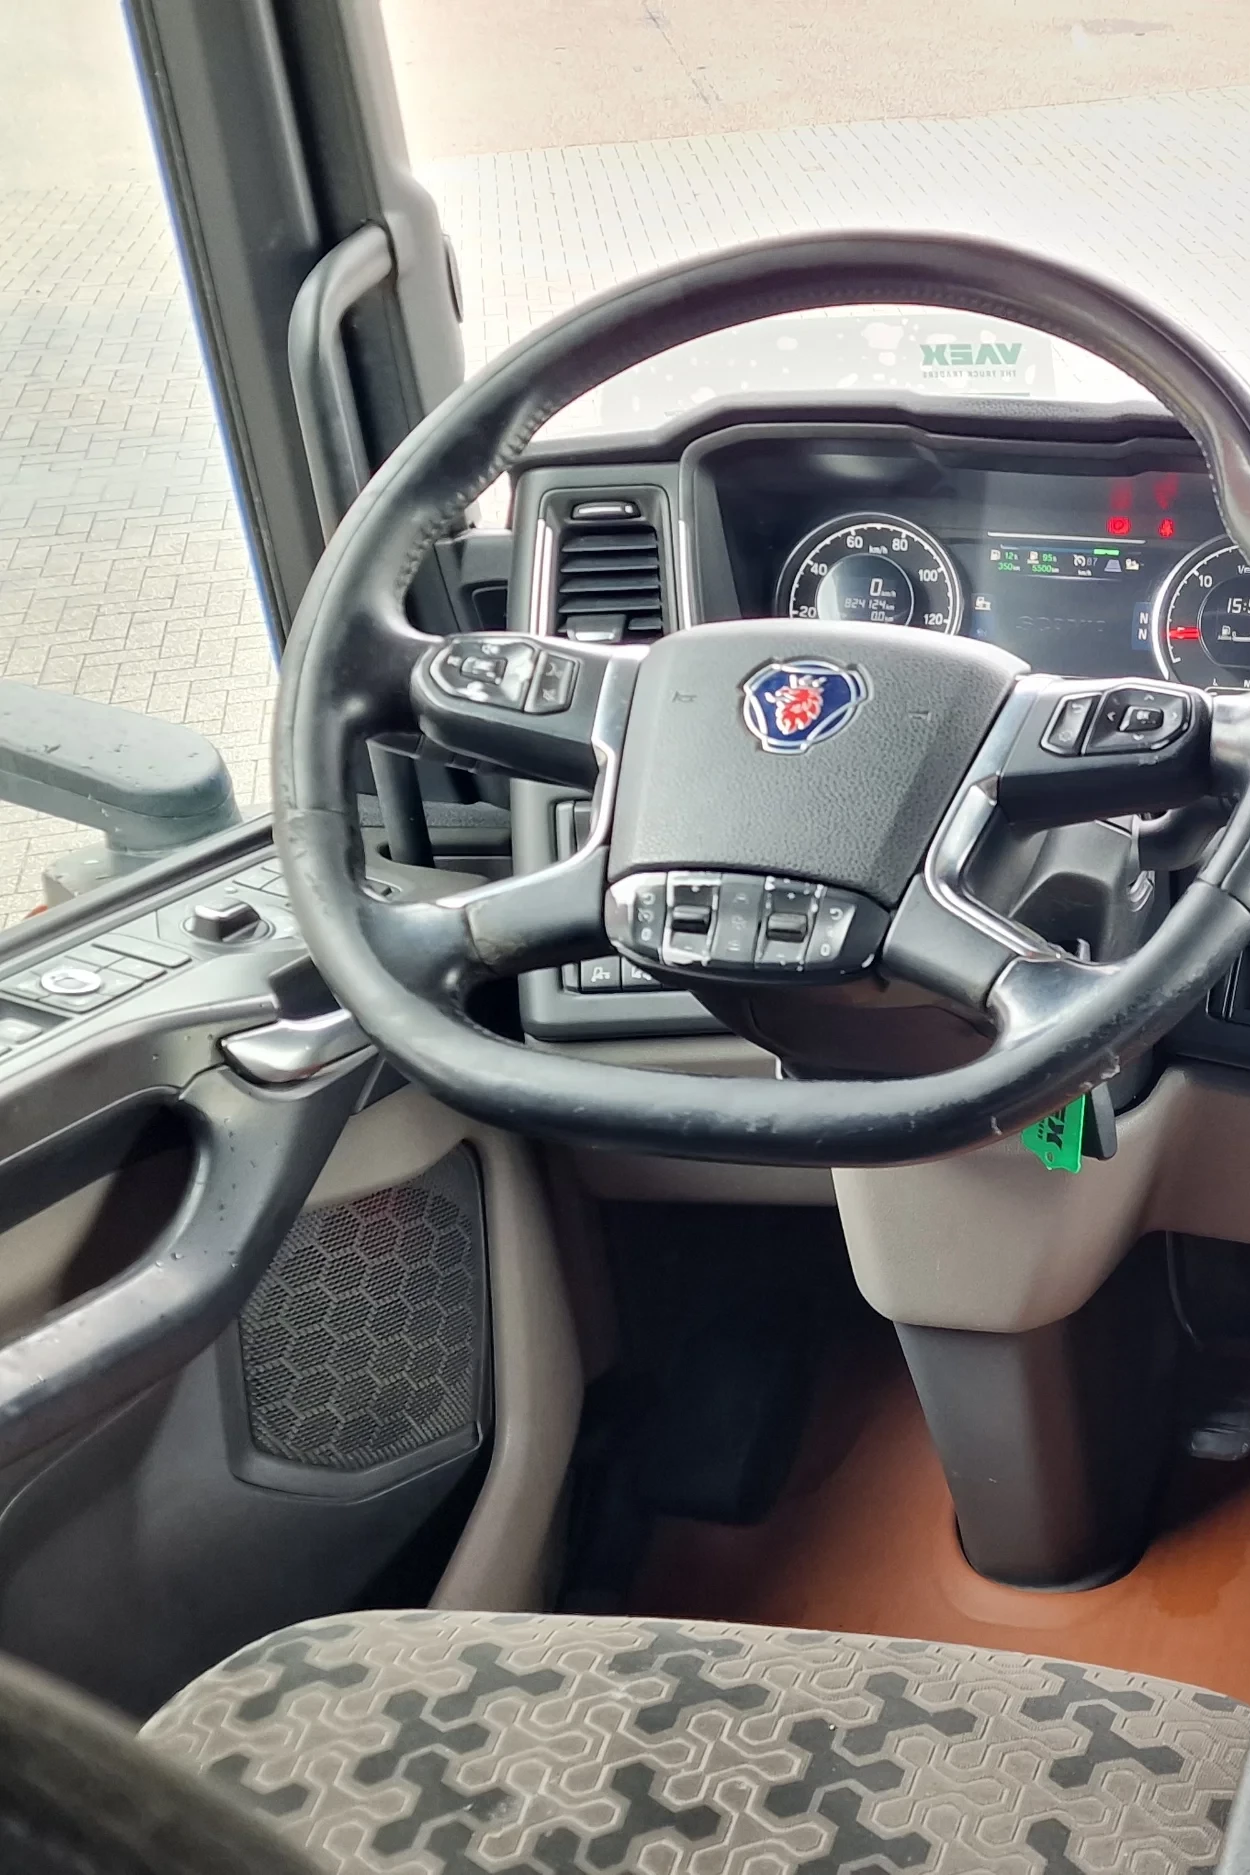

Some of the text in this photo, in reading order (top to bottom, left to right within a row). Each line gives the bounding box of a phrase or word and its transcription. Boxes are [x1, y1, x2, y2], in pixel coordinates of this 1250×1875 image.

[846, 535, 863, 549] 60
[892, 538, 908, 552] 80
[869, 545, 888, 555] km/h
[810, 563, 828, 576] 40
[918, 569, 938, 582] 100
[1198, 575, 1213, 588] 10
[800, 606, 817, 619] 20
[924, 613, 943, 625] 120
[1140, 612, 1149, 624] N
[1138, 628, 1148, 640] N
